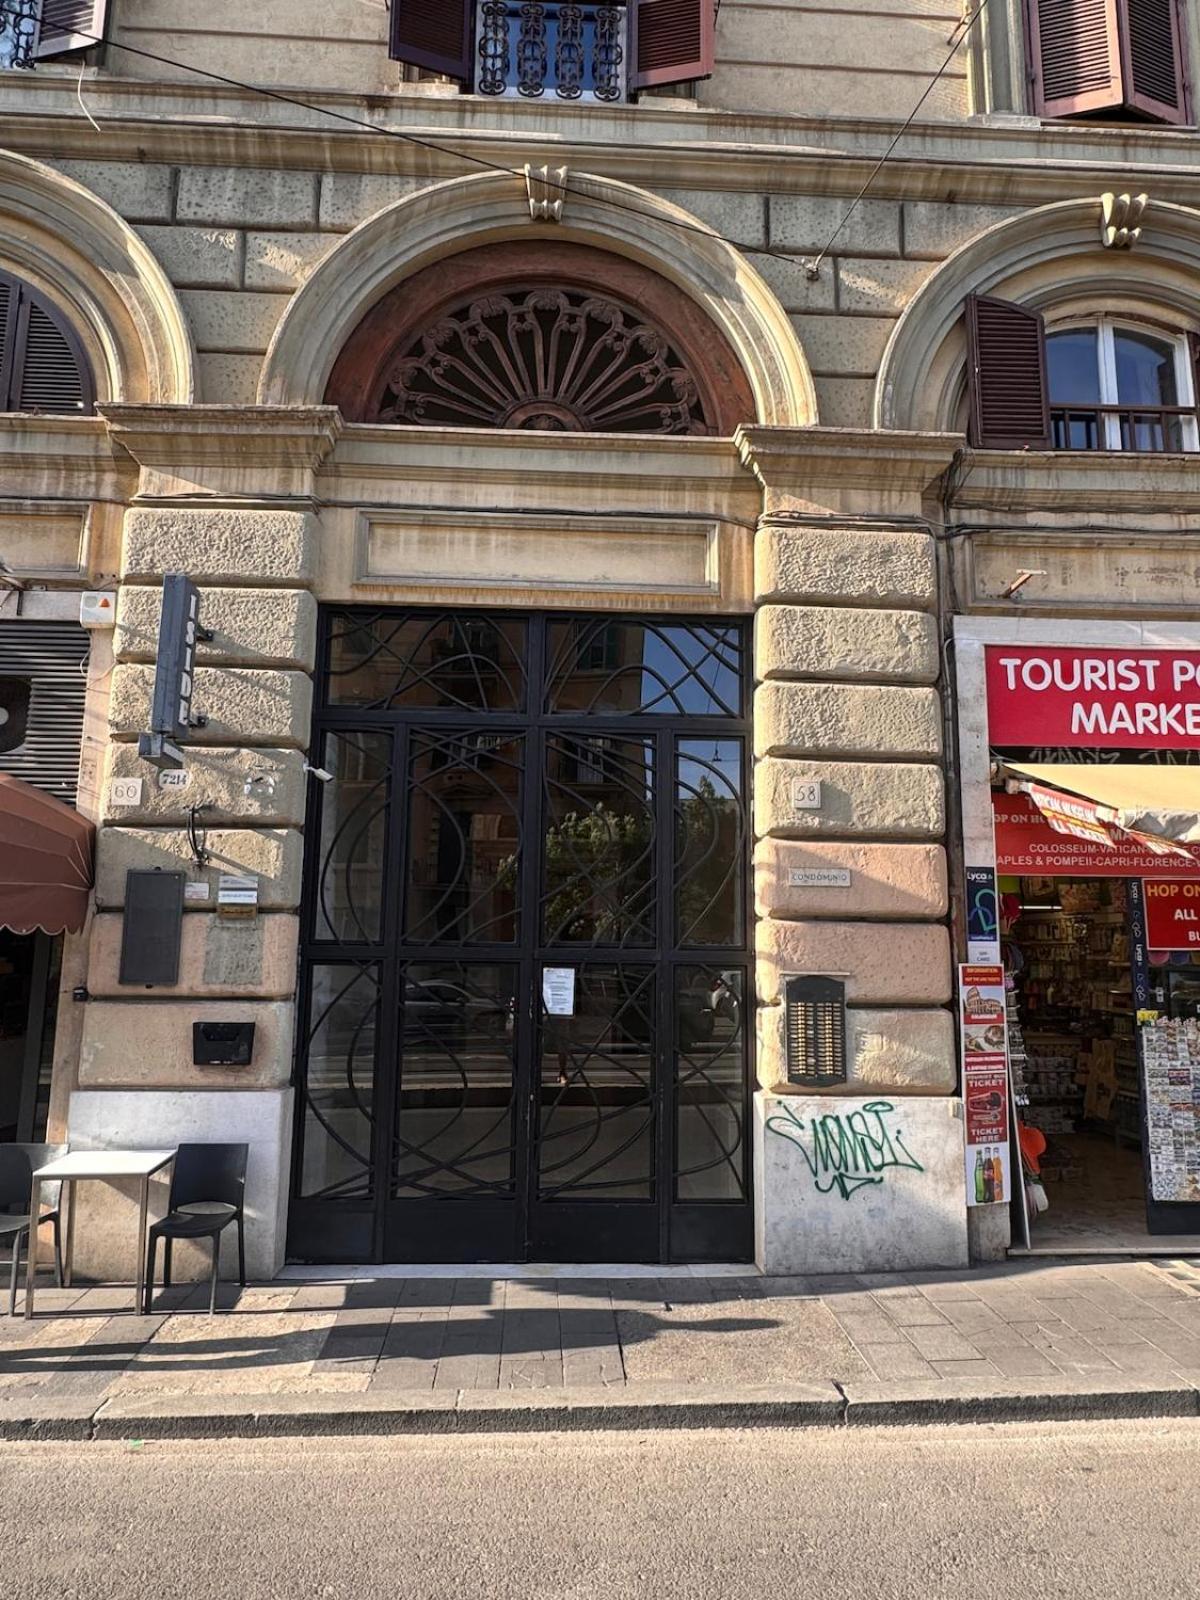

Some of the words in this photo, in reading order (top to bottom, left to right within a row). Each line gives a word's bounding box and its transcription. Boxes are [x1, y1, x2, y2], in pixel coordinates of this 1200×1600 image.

[999, 658, 1160, 691] TOURIST
[1172, 660, 1200, 691] P
[1071, 702, 1200, 735] MARKE
[162, 774, 187, 785] 7214
[114, 785, 138, 798] 60
[795, 785, 816, 801] 58
[1035, 855, 1044, 866] &
[1146, 884, 1180, 897] HOP
[1174, 908, 1199, 921] ALL
[968, 1079, 1003, 1088] TICKET
[971, 1127, 1004, 1136] TICKET
[975, 1135, 1000, 1143] HERE
